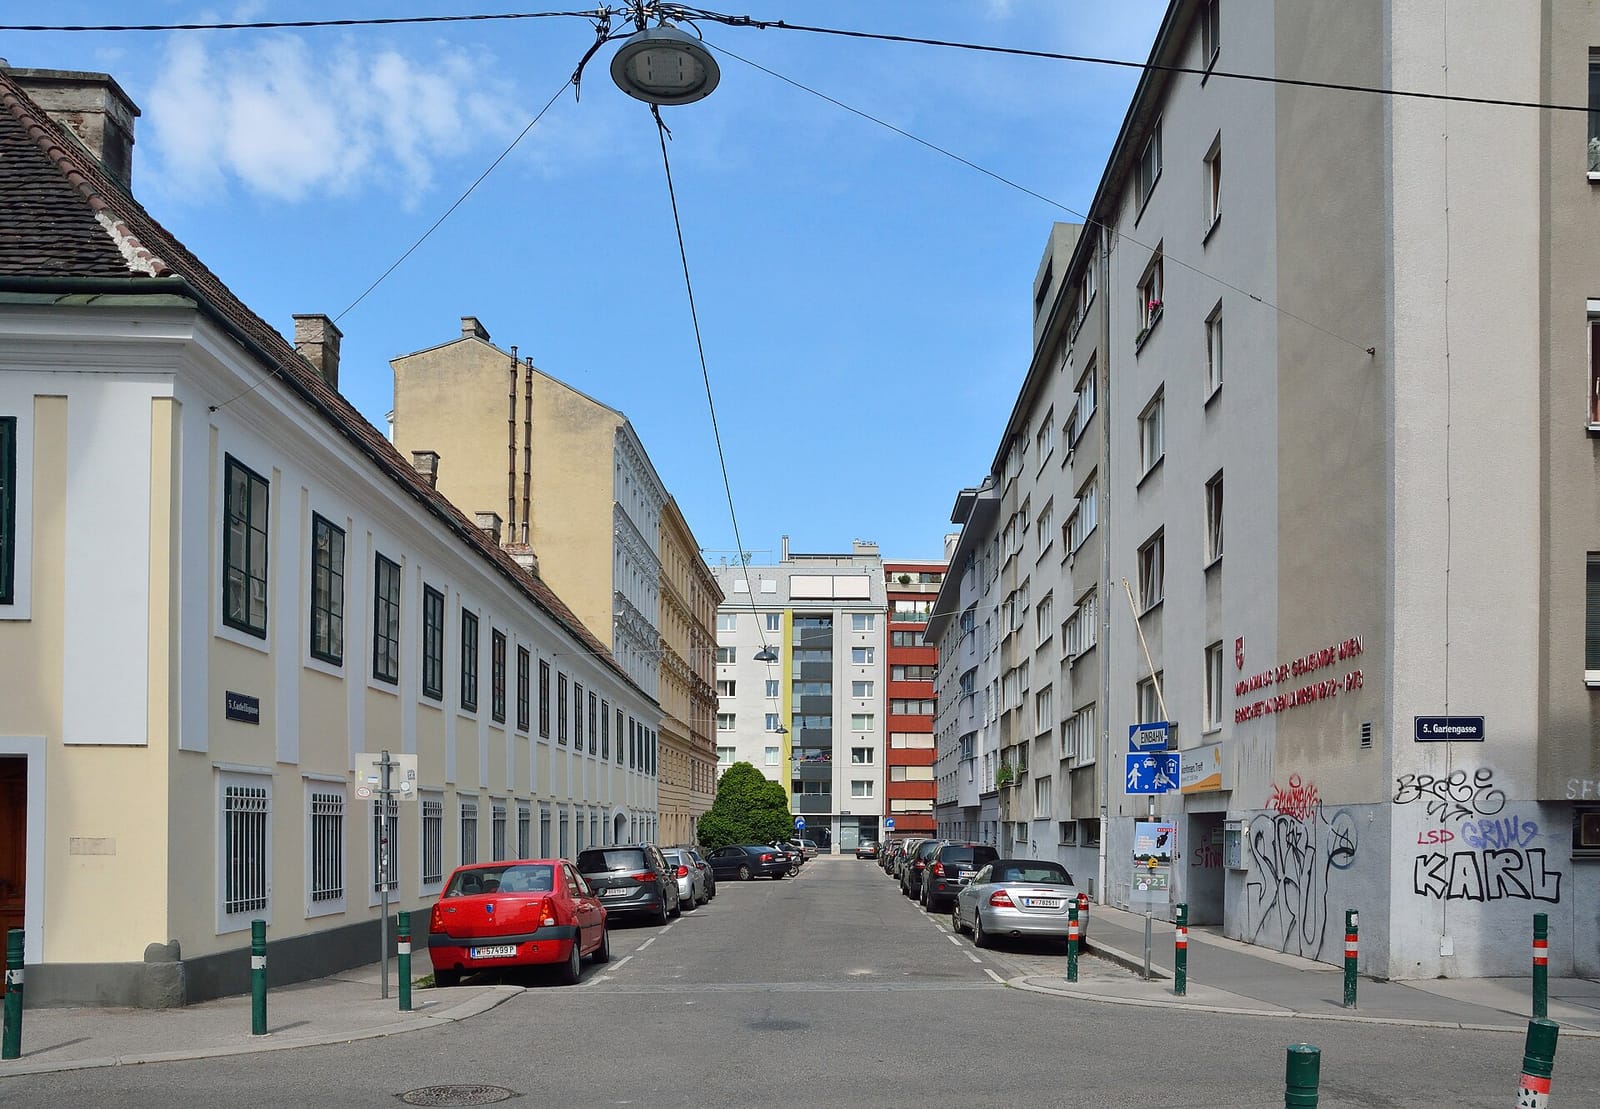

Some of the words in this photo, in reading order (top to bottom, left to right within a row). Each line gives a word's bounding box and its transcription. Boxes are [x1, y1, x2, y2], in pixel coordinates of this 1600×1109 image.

[1275, 663, 1290, 684] DER
[1337, 634, 1364, 661] WIEN
[1141, 729, 1164, 744] EINBAHN
[1433, 724, 1477, 735] Gartengasse
[1417, 830, 1455, 845] LSD
[1414, 848, 1562, 903] KARL
